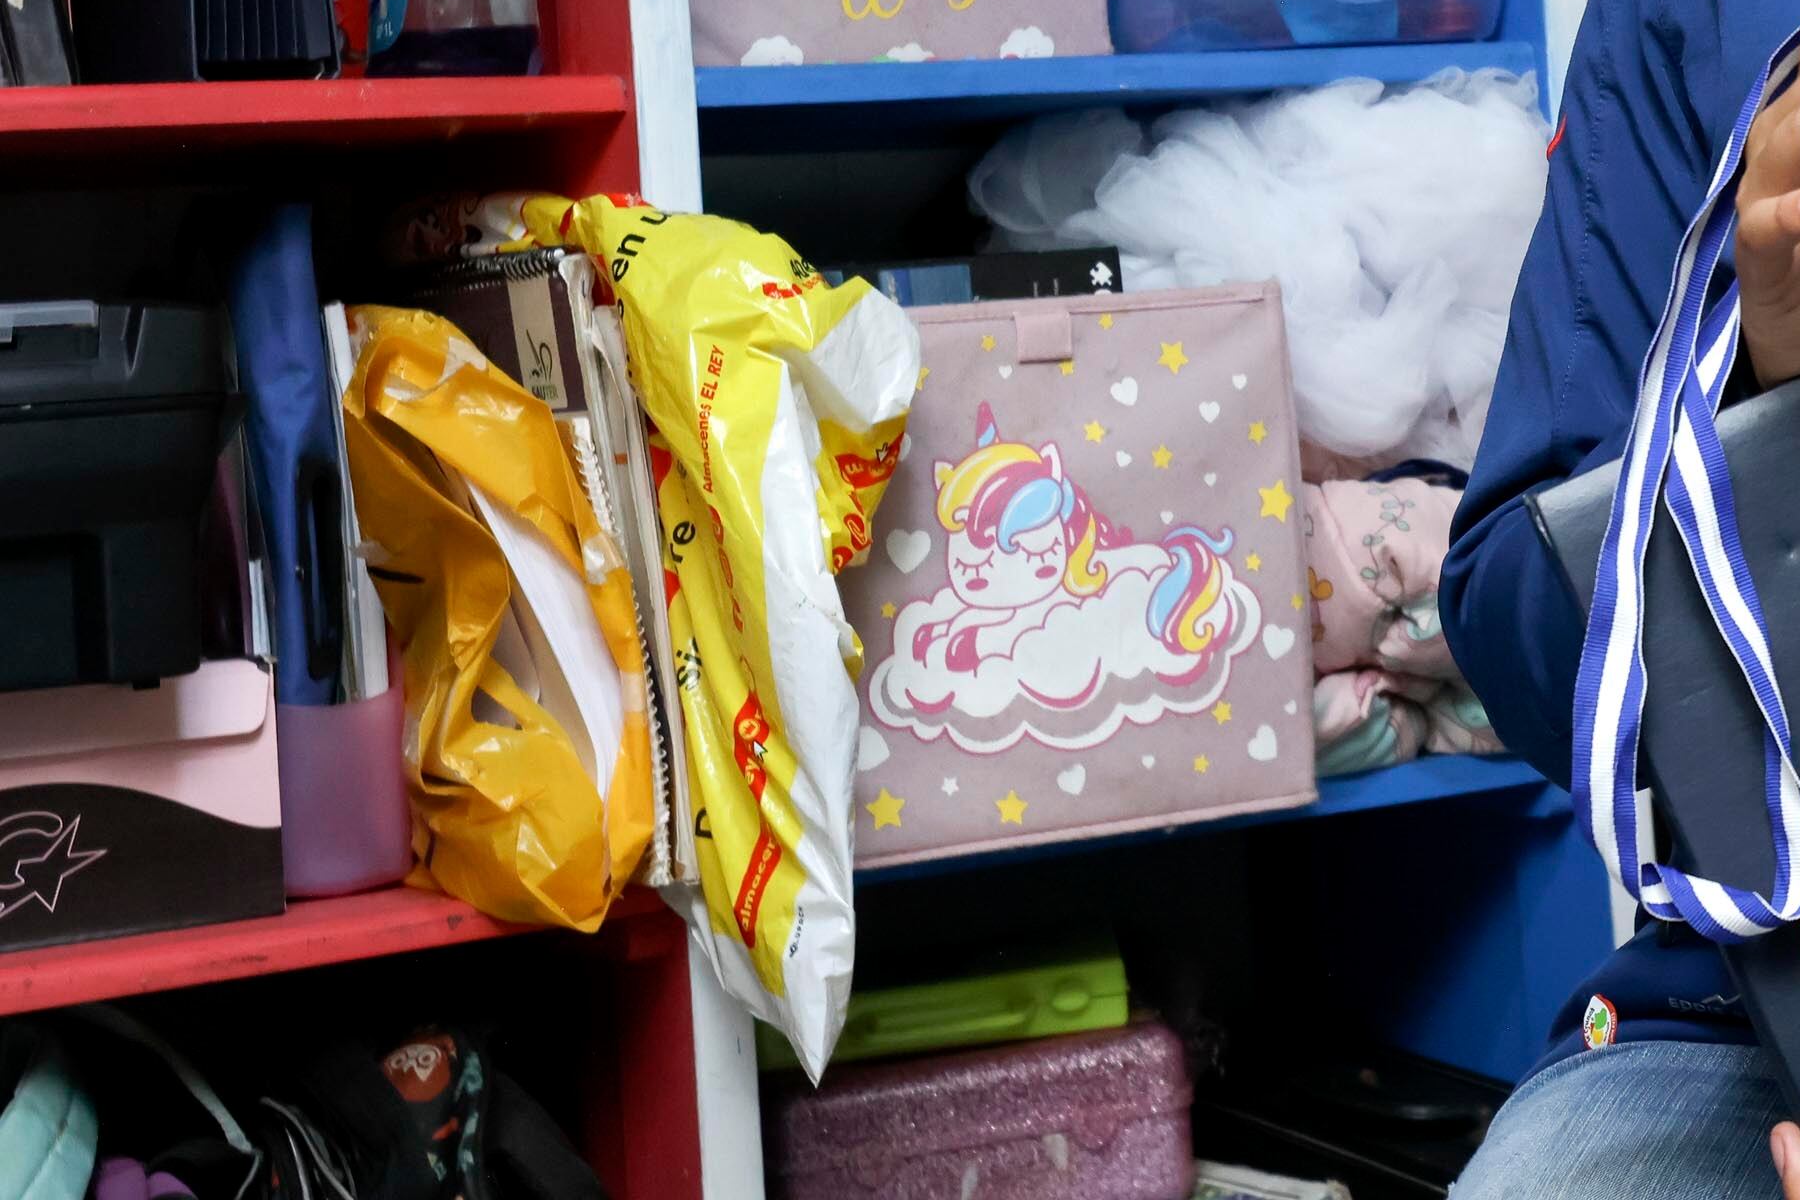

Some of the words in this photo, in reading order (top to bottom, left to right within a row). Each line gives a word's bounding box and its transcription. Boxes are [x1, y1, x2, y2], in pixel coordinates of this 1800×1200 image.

[708, 344, 725, 377] REY
[700, 381, 718, 401] EL
[698, 403, 713, 493] Almacenes
